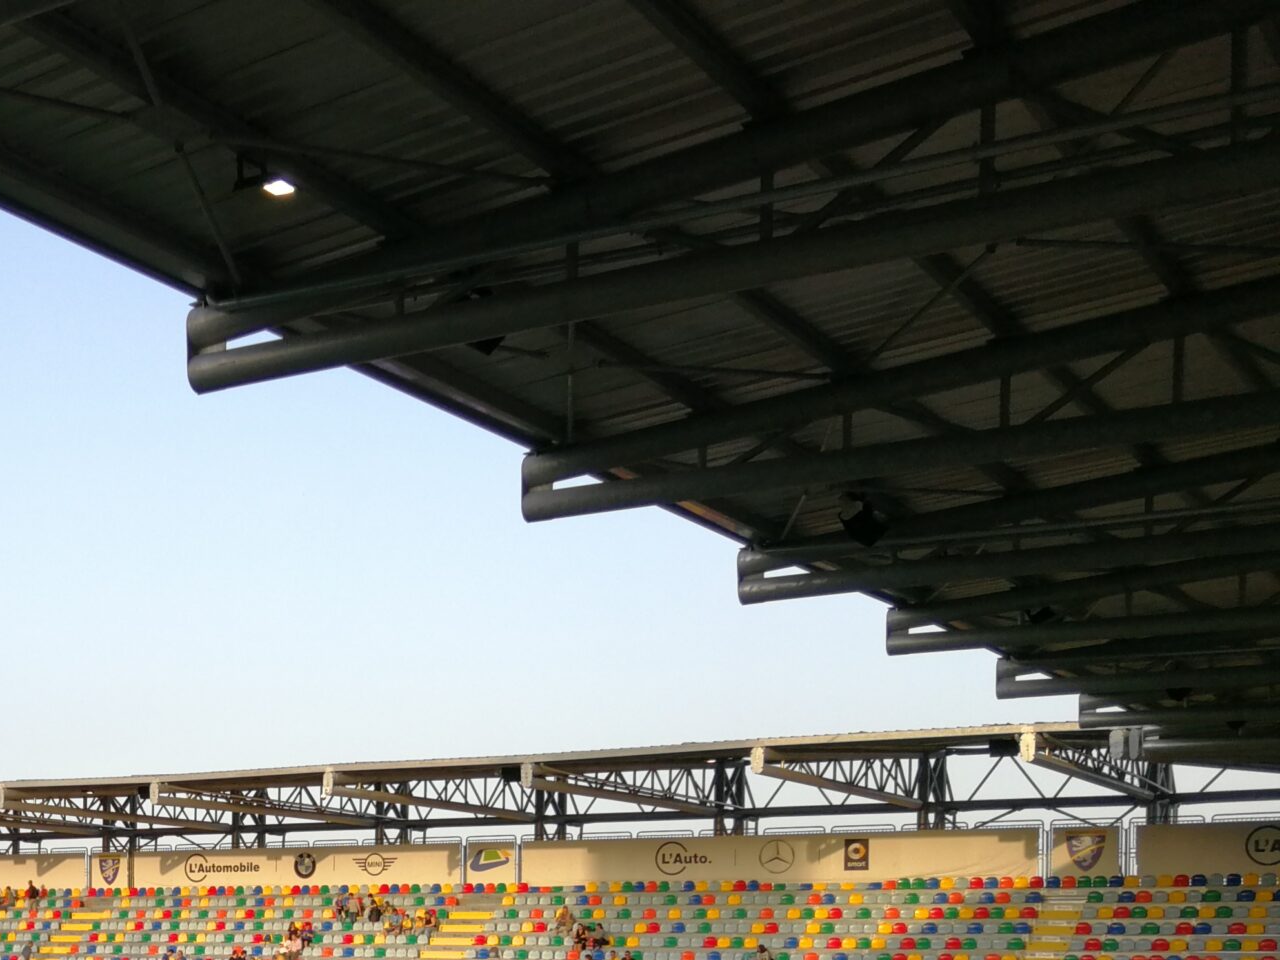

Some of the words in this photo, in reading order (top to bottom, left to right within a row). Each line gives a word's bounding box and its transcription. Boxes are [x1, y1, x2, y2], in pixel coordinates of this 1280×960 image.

[367, 860, 382, 868] MINI
[661, 852, 712, 865] L'Auto.
[189, 862, 260, 874] L'Automobile
